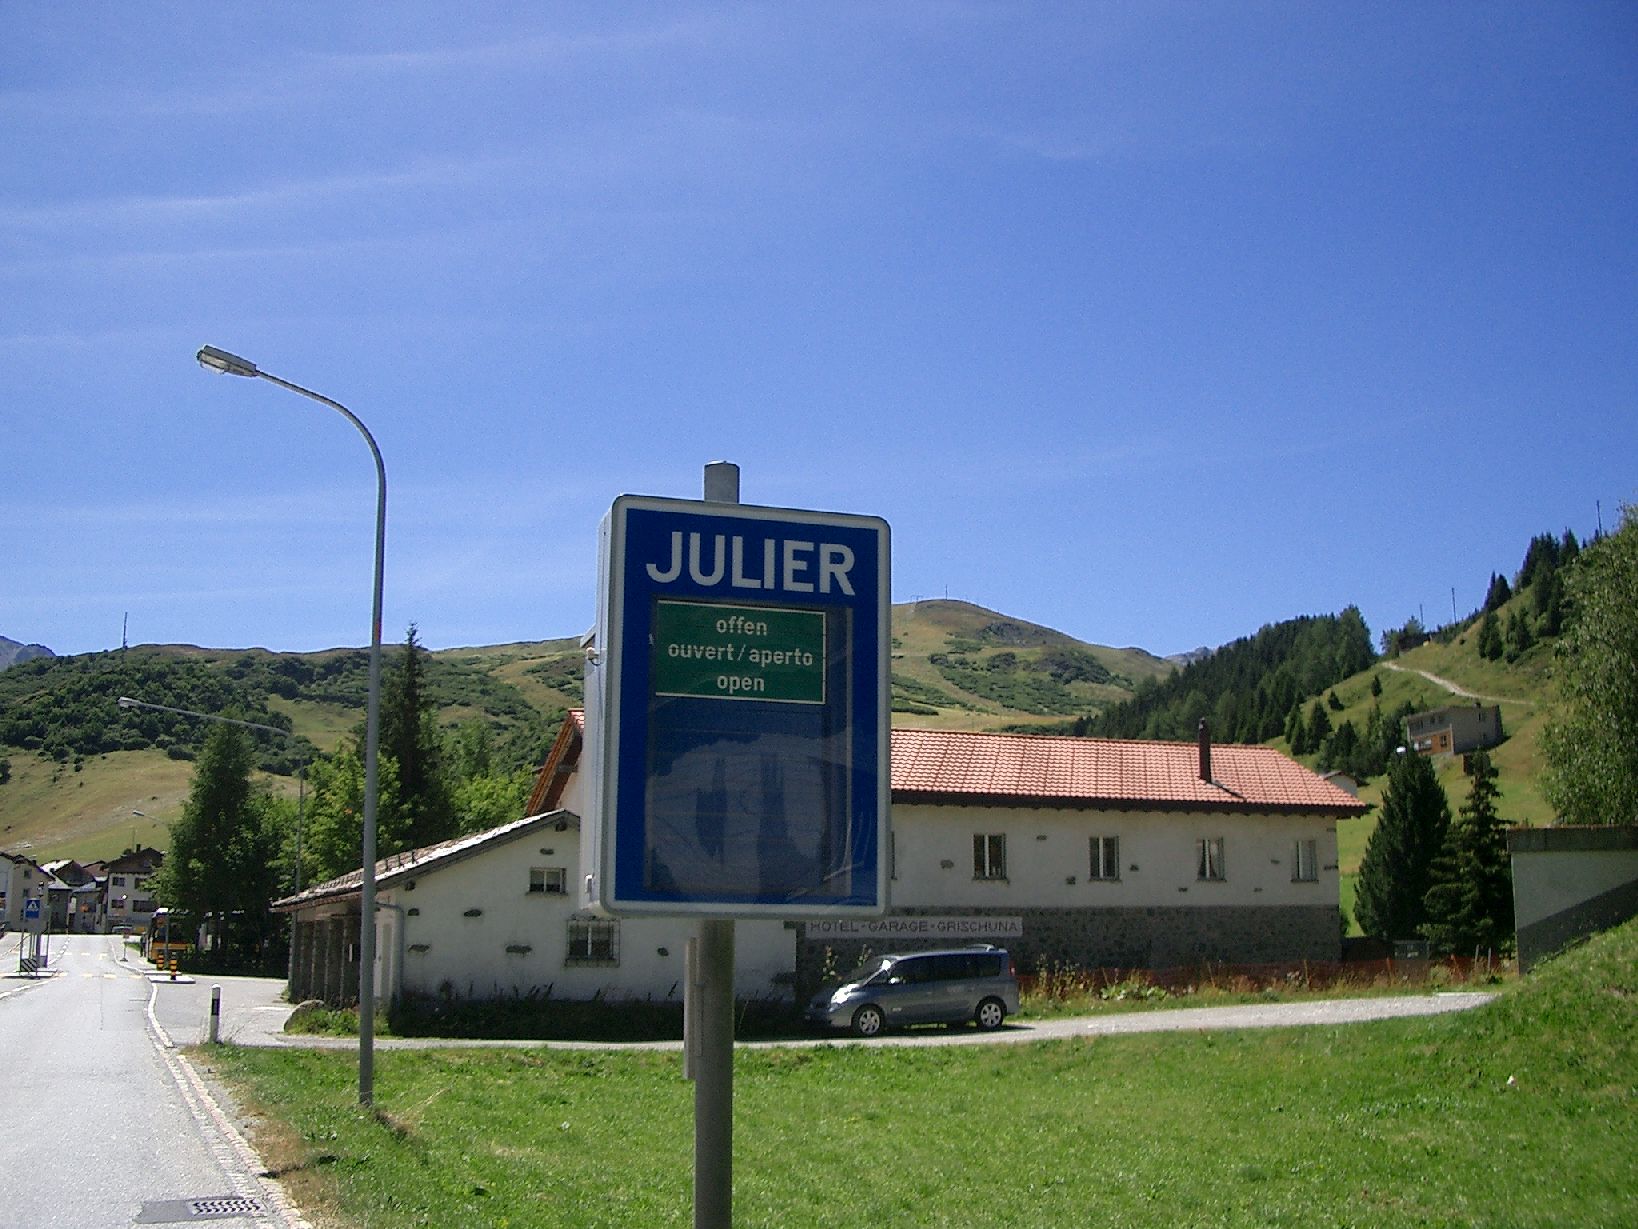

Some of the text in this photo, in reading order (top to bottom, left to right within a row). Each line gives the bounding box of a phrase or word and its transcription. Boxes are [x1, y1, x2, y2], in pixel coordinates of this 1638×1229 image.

[646, 531, 855, 596] JULIER
[716, 615, 768, 635] offen
[717, 674, 765, 693] open
